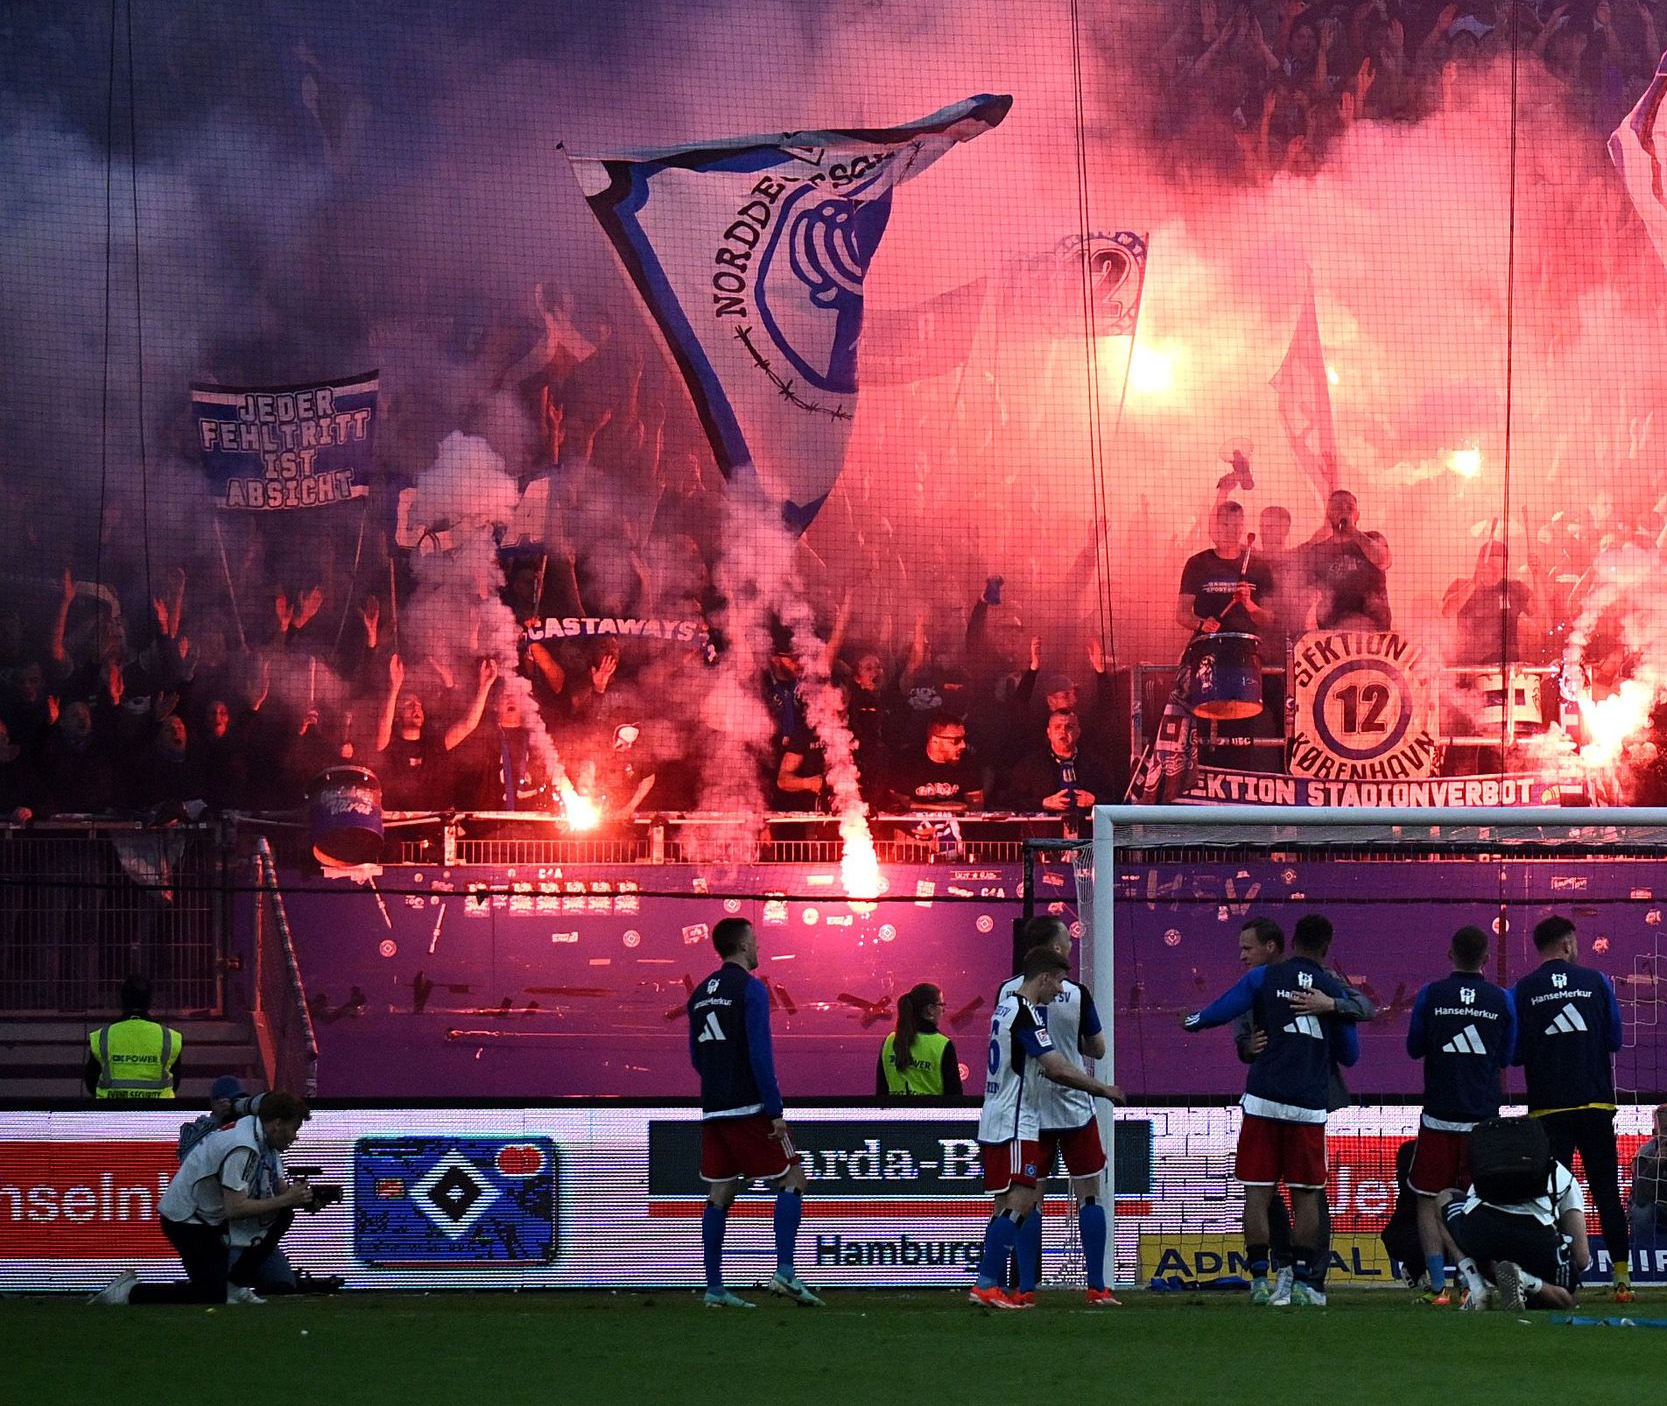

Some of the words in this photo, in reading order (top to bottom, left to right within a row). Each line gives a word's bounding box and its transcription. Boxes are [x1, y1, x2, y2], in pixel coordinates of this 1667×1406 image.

[236, 387, 337, 424] JEDER
[199, 408, 371, 453] FEHLTRITT
[261, 448, 320, 480] IST
[226, 467, 354, 510] ABSICHT
[528, 617, 698, 642] CASTAWAYS
[1294, 633, 1408, 688] SEKTION
[1335, 684, 1390, 734] 12
[1292, 731, 1436, 781] KØBENHAVN
[1195, 772, 1297, 806] EKTION
[1307, 778, 1538, 808] STADIONVERBOT
[1433, 1005, 1499, 1021] HanseMerkur
[1530, 989, 1592, 1006] HanseMerkur
[125, 1055, 159, 1063] POWER
